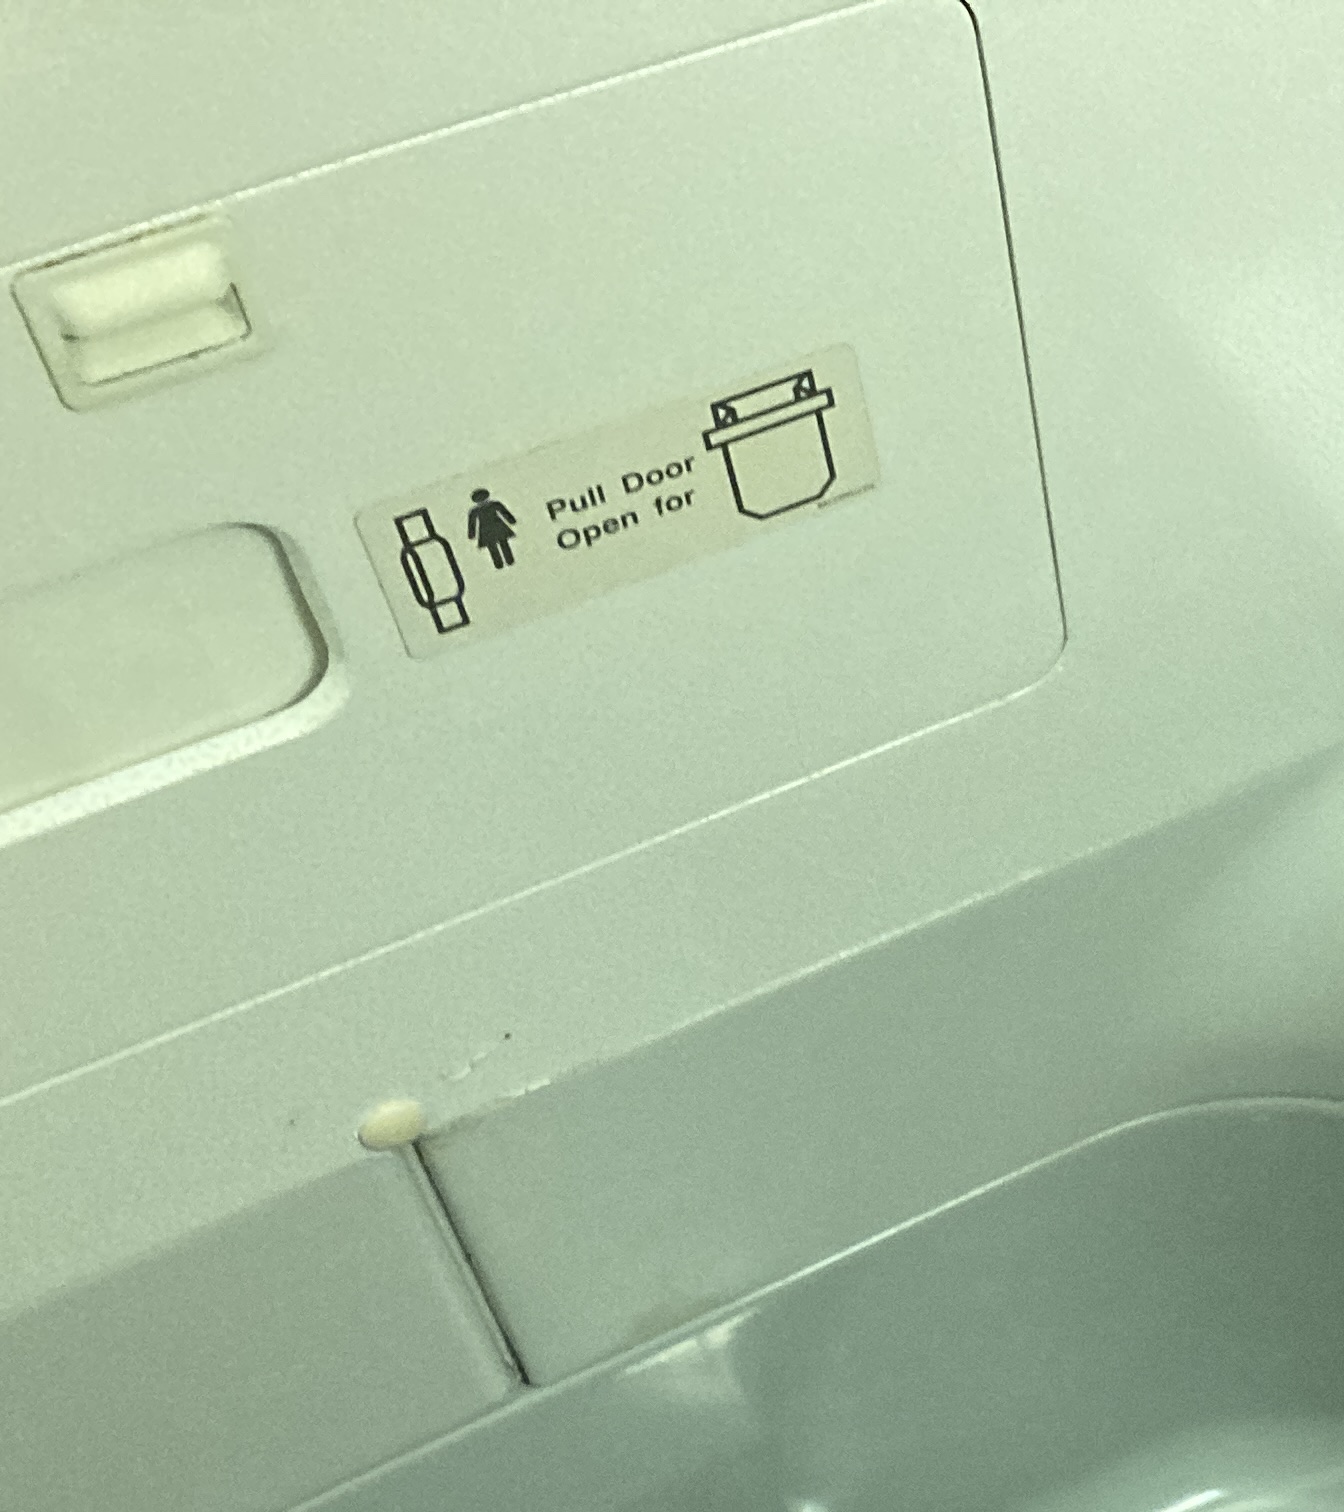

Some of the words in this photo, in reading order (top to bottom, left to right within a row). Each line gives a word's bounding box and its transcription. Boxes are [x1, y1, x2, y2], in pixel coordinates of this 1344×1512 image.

[546, 484, 606, 520] Pull
[622, 456, 696, 495] Door
[557, 511, 639, 552] Open
[654, 489, 696, 517] for
